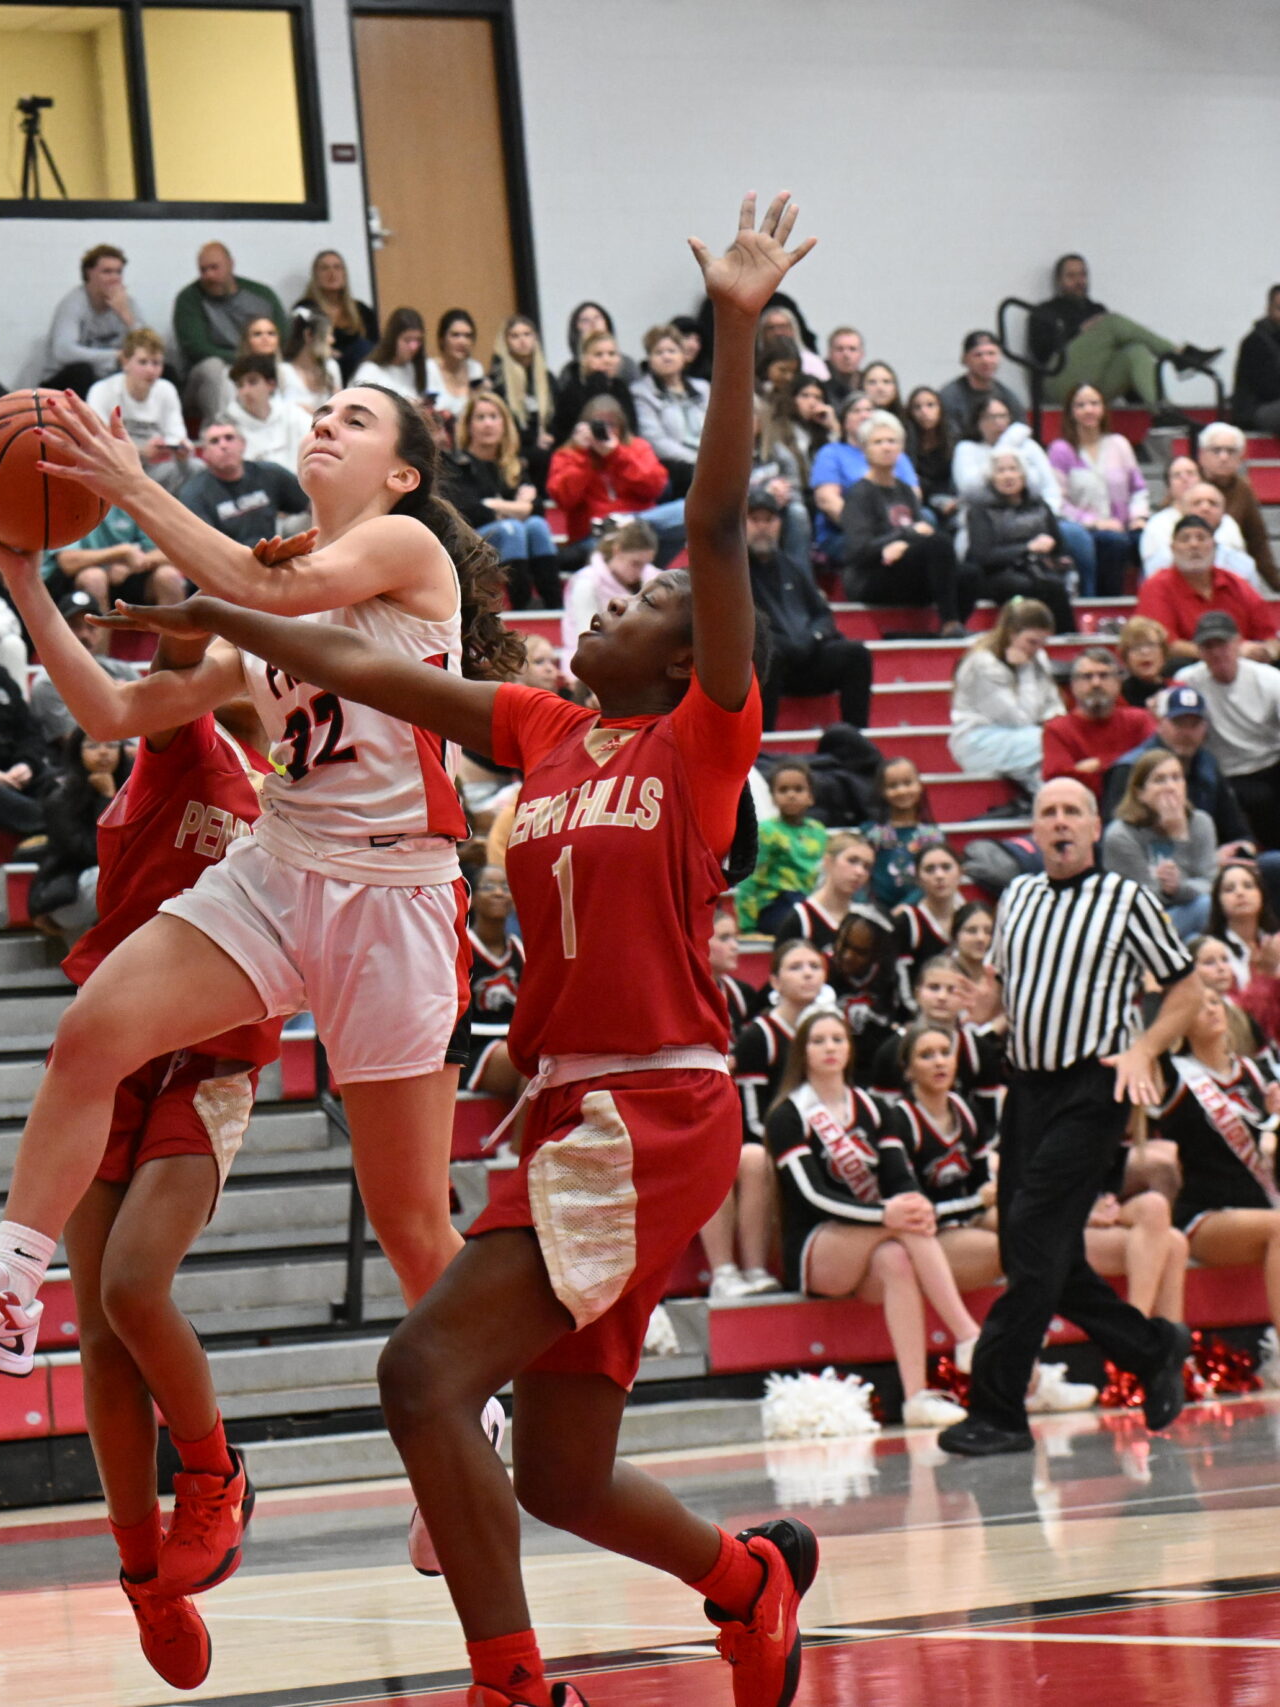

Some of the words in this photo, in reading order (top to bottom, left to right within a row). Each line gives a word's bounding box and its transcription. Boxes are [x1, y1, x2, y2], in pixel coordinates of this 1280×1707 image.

[507, 787, 580, 850] ENN
[567, 775, 664, 831] HILLS
[551, 844, 577, 960] 1
